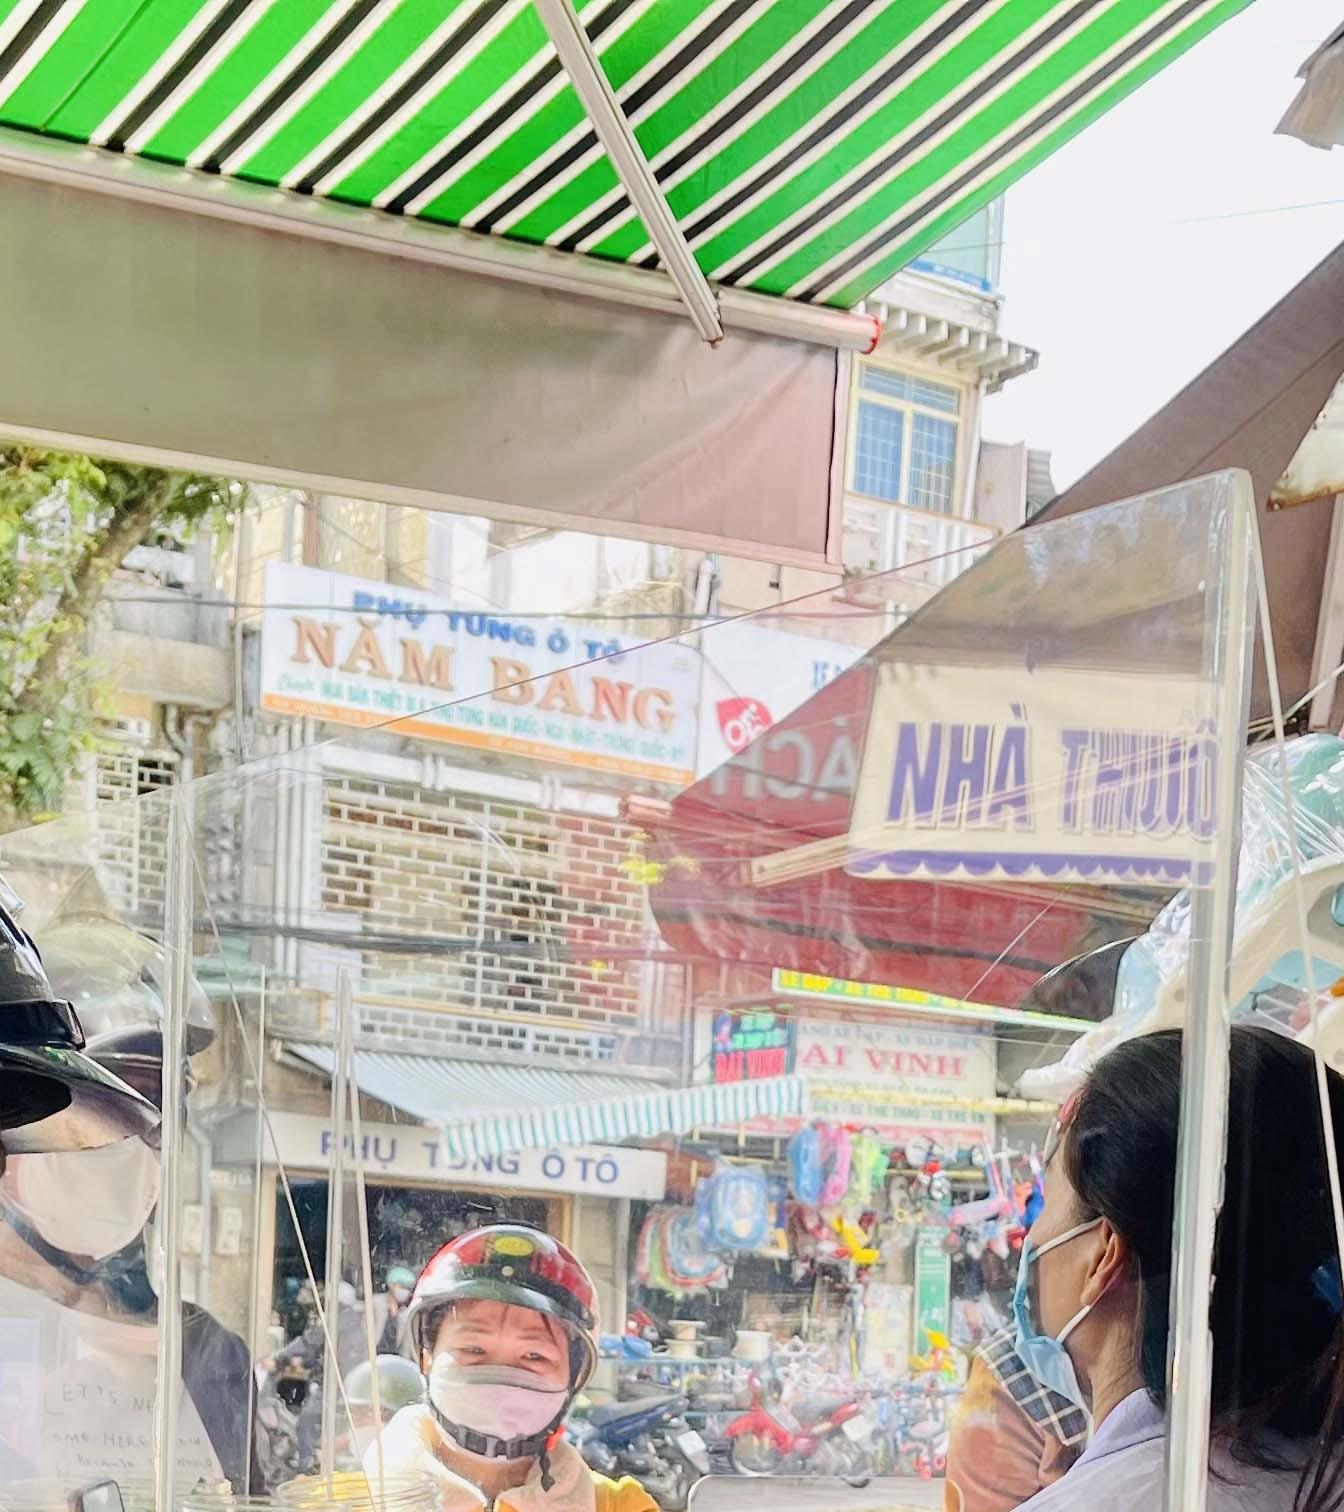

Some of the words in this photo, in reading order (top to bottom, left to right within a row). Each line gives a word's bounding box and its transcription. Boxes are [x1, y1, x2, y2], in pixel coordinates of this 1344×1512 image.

[290, 614, 456, 691] NĂM
[489, 656, 677, 734] BANG
[884, 705, 1036, 829] NHÀ
[865, 1046, 969, 1078] VINH
[541, 1150, 567, 1180] Ô
[576, 1152, 620, 1185] TÔ
